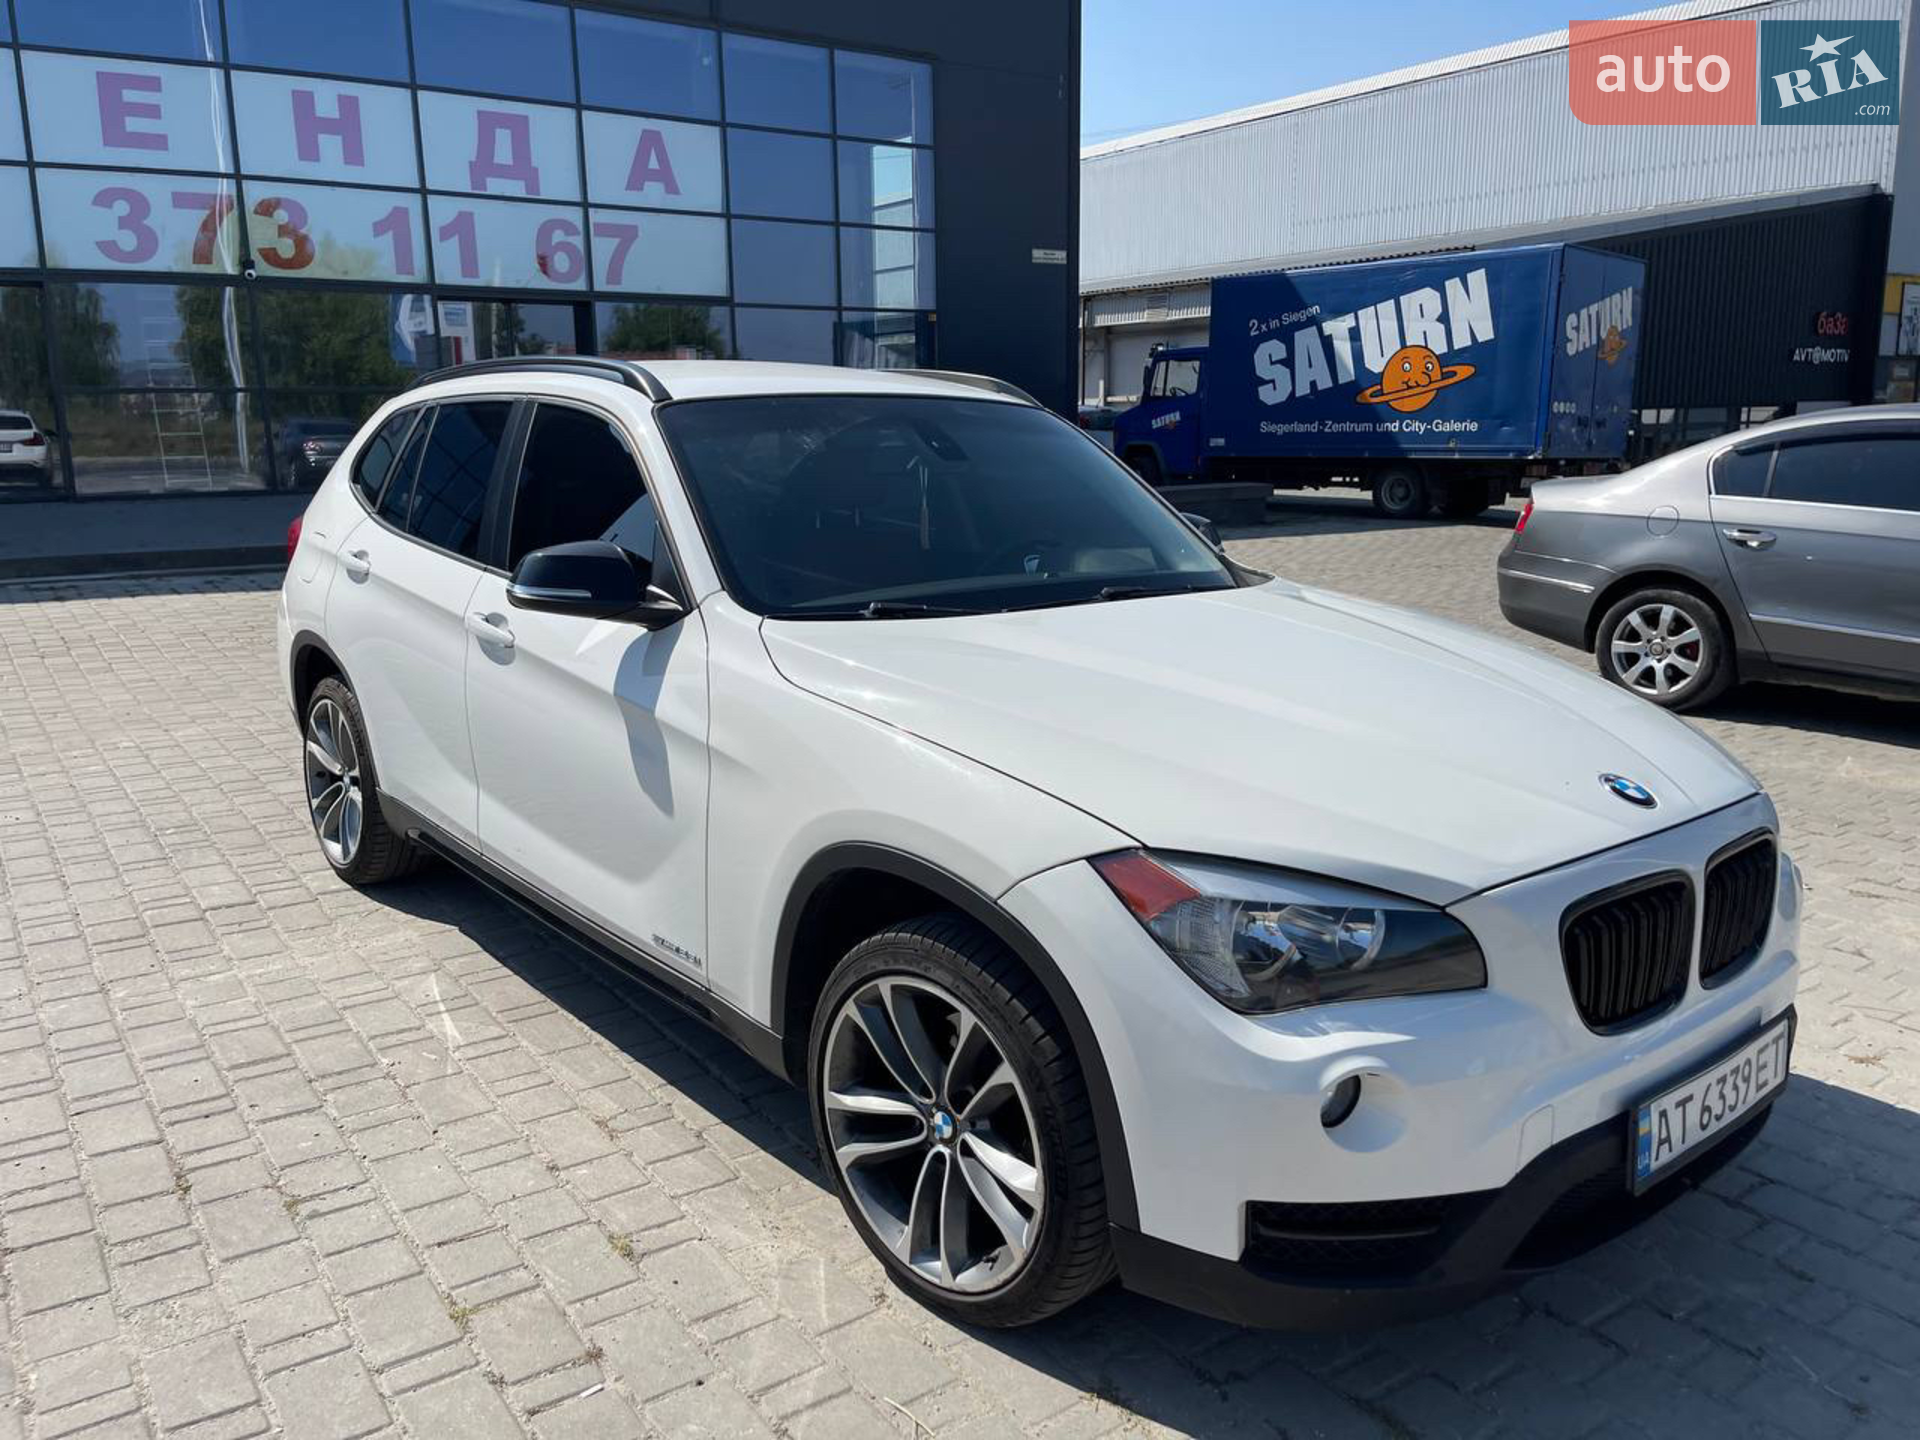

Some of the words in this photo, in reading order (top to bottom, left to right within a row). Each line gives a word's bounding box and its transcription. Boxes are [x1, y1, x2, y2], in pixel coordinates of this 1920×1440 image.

[91, 187, 315, 271] 373
[372, 206, 480, 280] 11
[535, 218, 640, 286] 67
[1253, 268, 1495, 406] SATURN
[1281, 305, 1321, 325] Siegen
[1565, 286, 1633, 357] SATURN
[1376, 419, 1399, 433] und
[1402, 418, 1478, 435] City-Galerie
